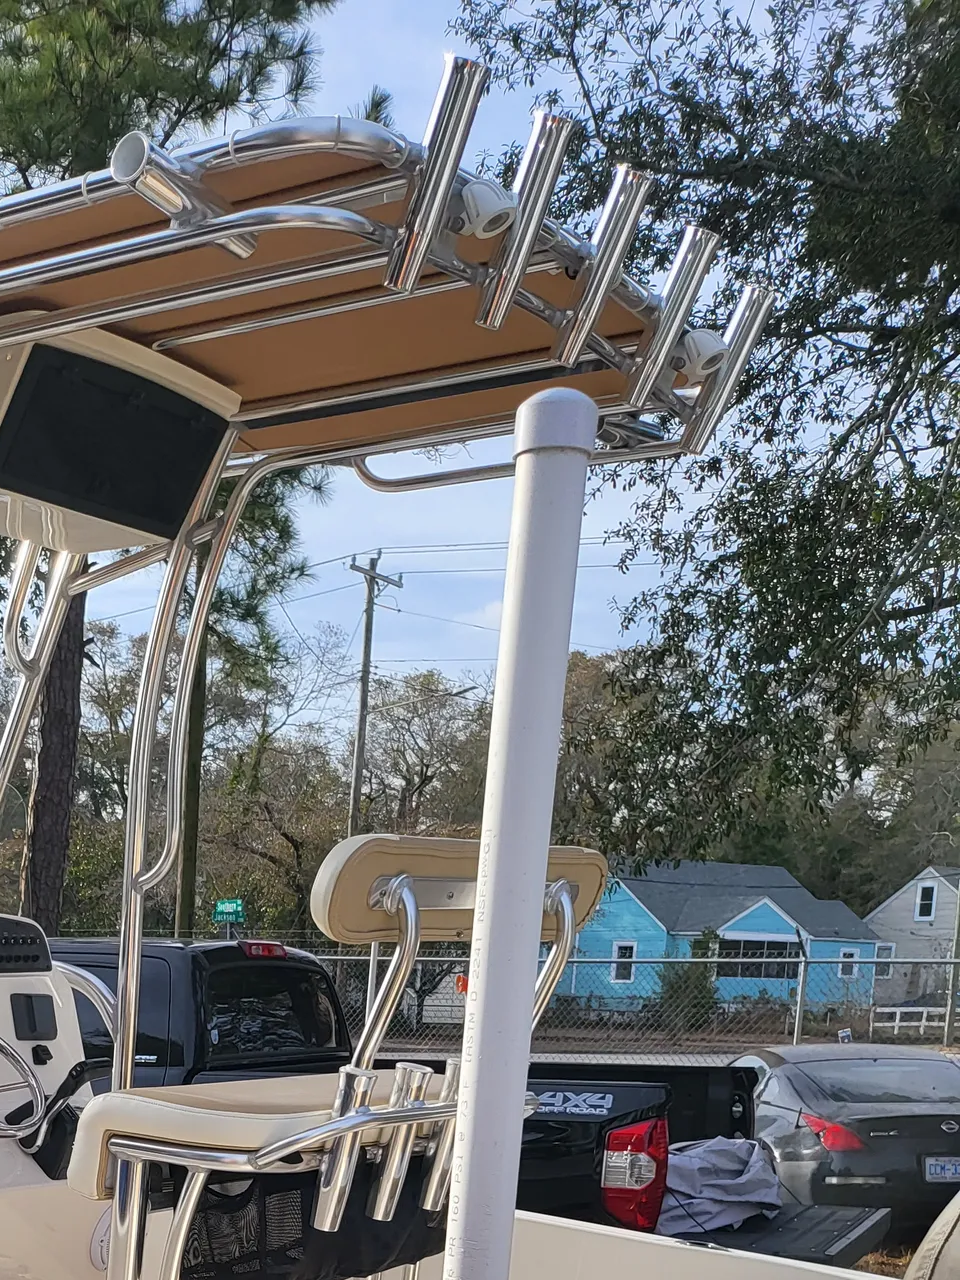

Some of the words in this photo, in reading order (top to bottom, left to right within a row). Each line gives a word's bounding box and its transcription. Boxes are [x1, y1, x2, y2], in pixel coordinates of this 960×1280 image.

[214, 913, 236, 921] Jackson
[538, 1091, 614, 1108] 4X4
[566, 1106, 609, 1115] ROAD
[454, 1153, 464, 1184] PSI
[450, 1194, 460, 1223] 160
[448, 1235, 457, 1258] PR
